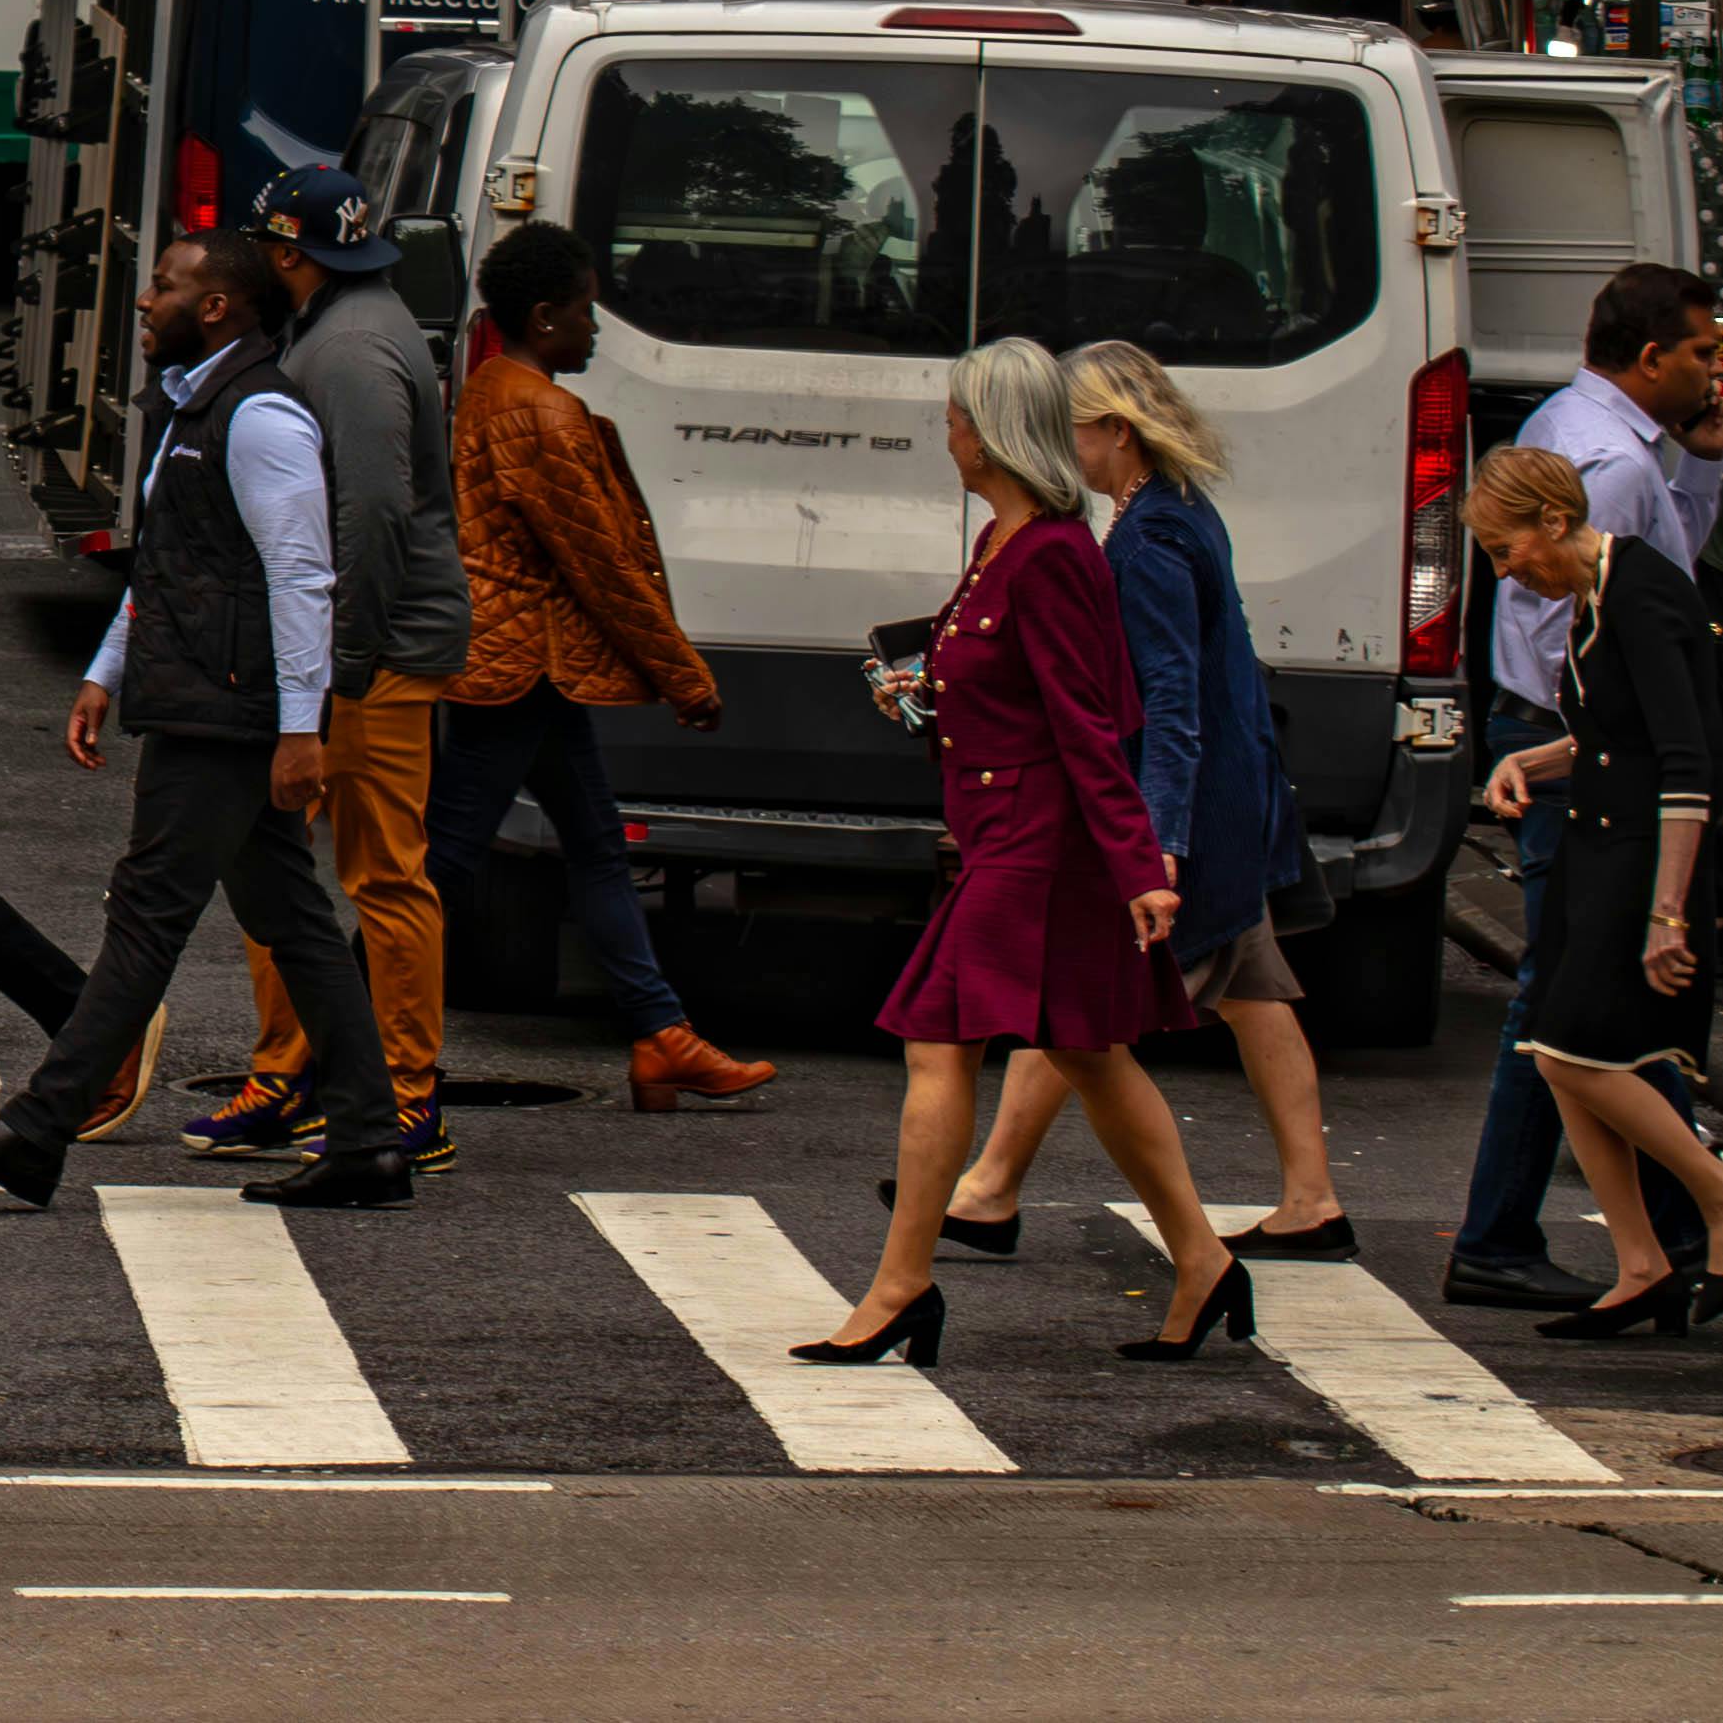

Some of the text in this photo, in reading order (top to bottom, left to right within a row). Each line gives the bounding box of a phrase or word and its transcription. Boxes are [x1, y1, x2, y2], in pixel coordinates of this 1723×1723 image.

[334, 195, 369, 246] NY
[673, 423, 913, 452] TRANSIT 150
